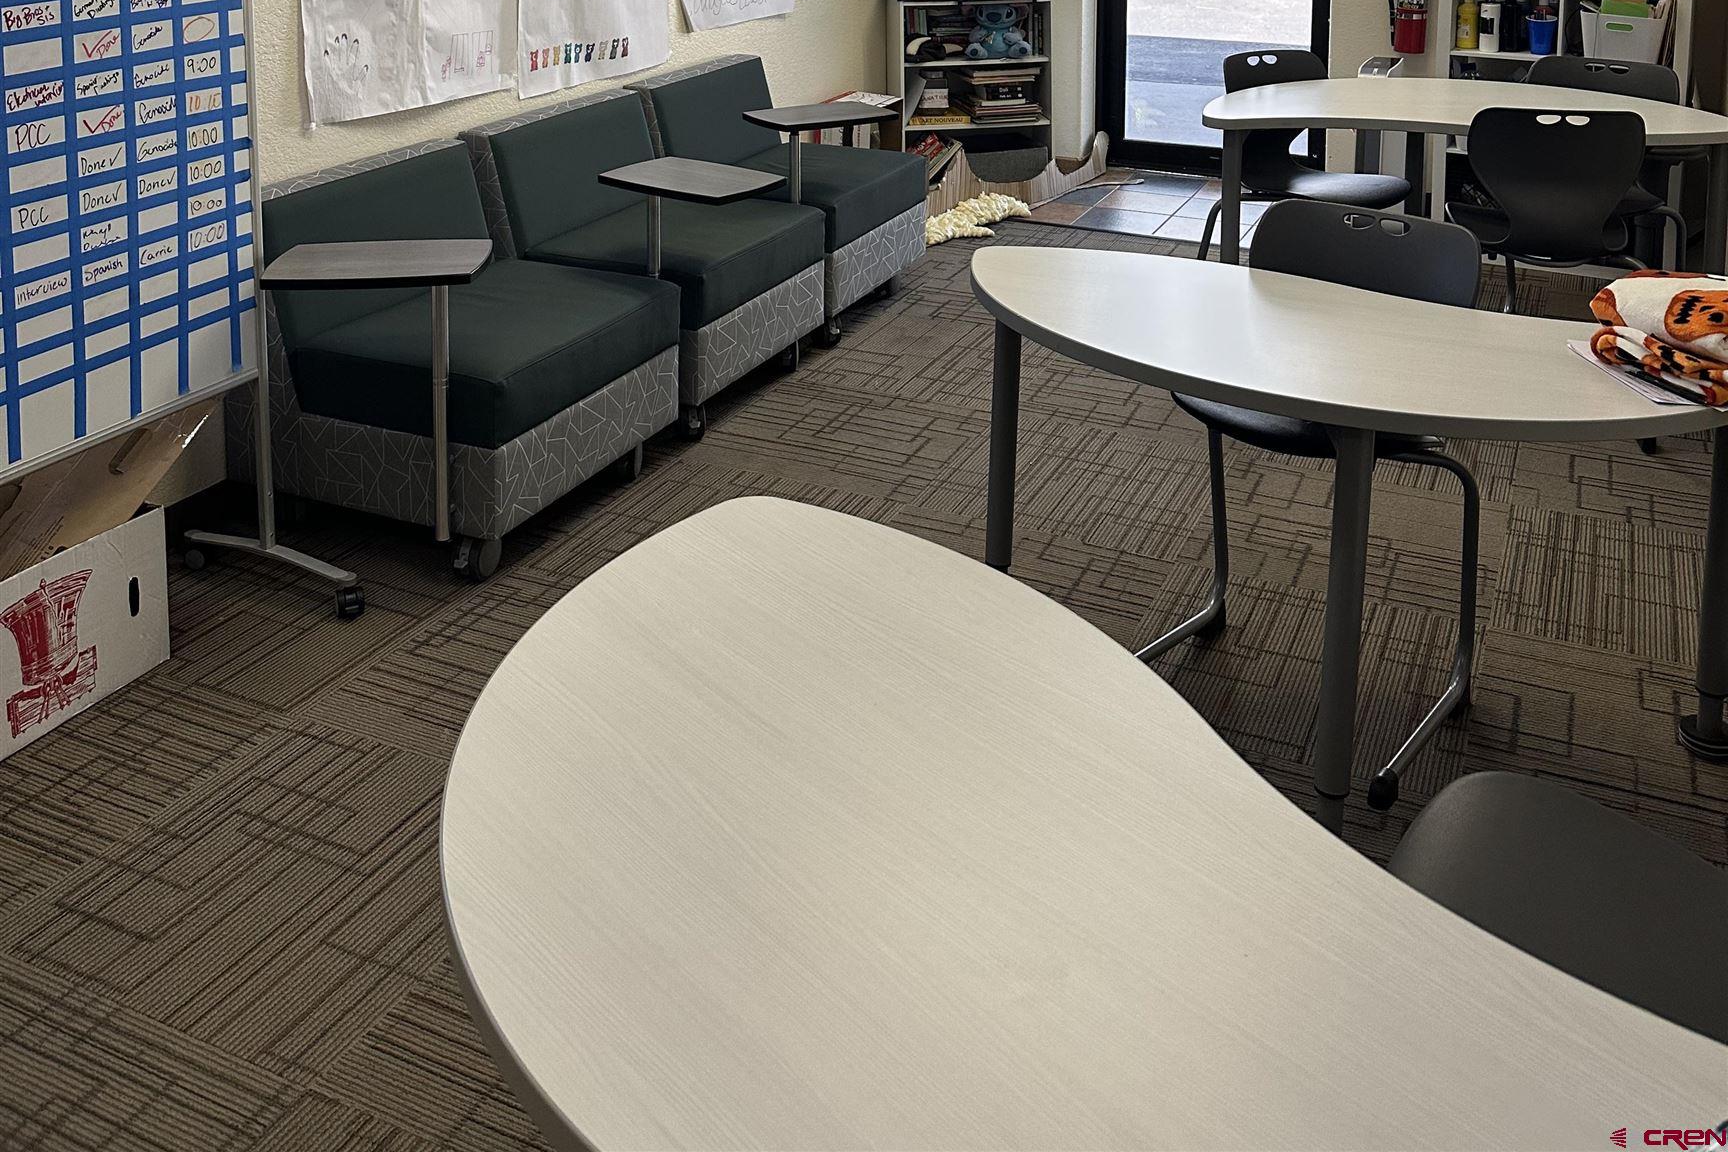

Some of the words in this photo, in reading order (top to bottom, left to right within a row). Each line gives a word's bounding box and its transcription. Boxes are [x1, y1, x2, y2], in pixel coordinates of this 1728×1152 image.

[187, 56, 217, 74] 9:00
[100, 111, 122, 133] Done
[15, 123, 51, 152] PCC
[81, 157, 106, 176] Done
[190, 160, 222, 182] 10:00
[139, 177, 168, 195] Done
[83, 192, 112, 212] Done
[190, 199, 223, 215] 10:00
[18, 206, 49, 229] PCC
[190, 222, 226, 252] 10:00
[140, 245, 173, 265] Carrie
[84, 258, 123, 282] Spanish
